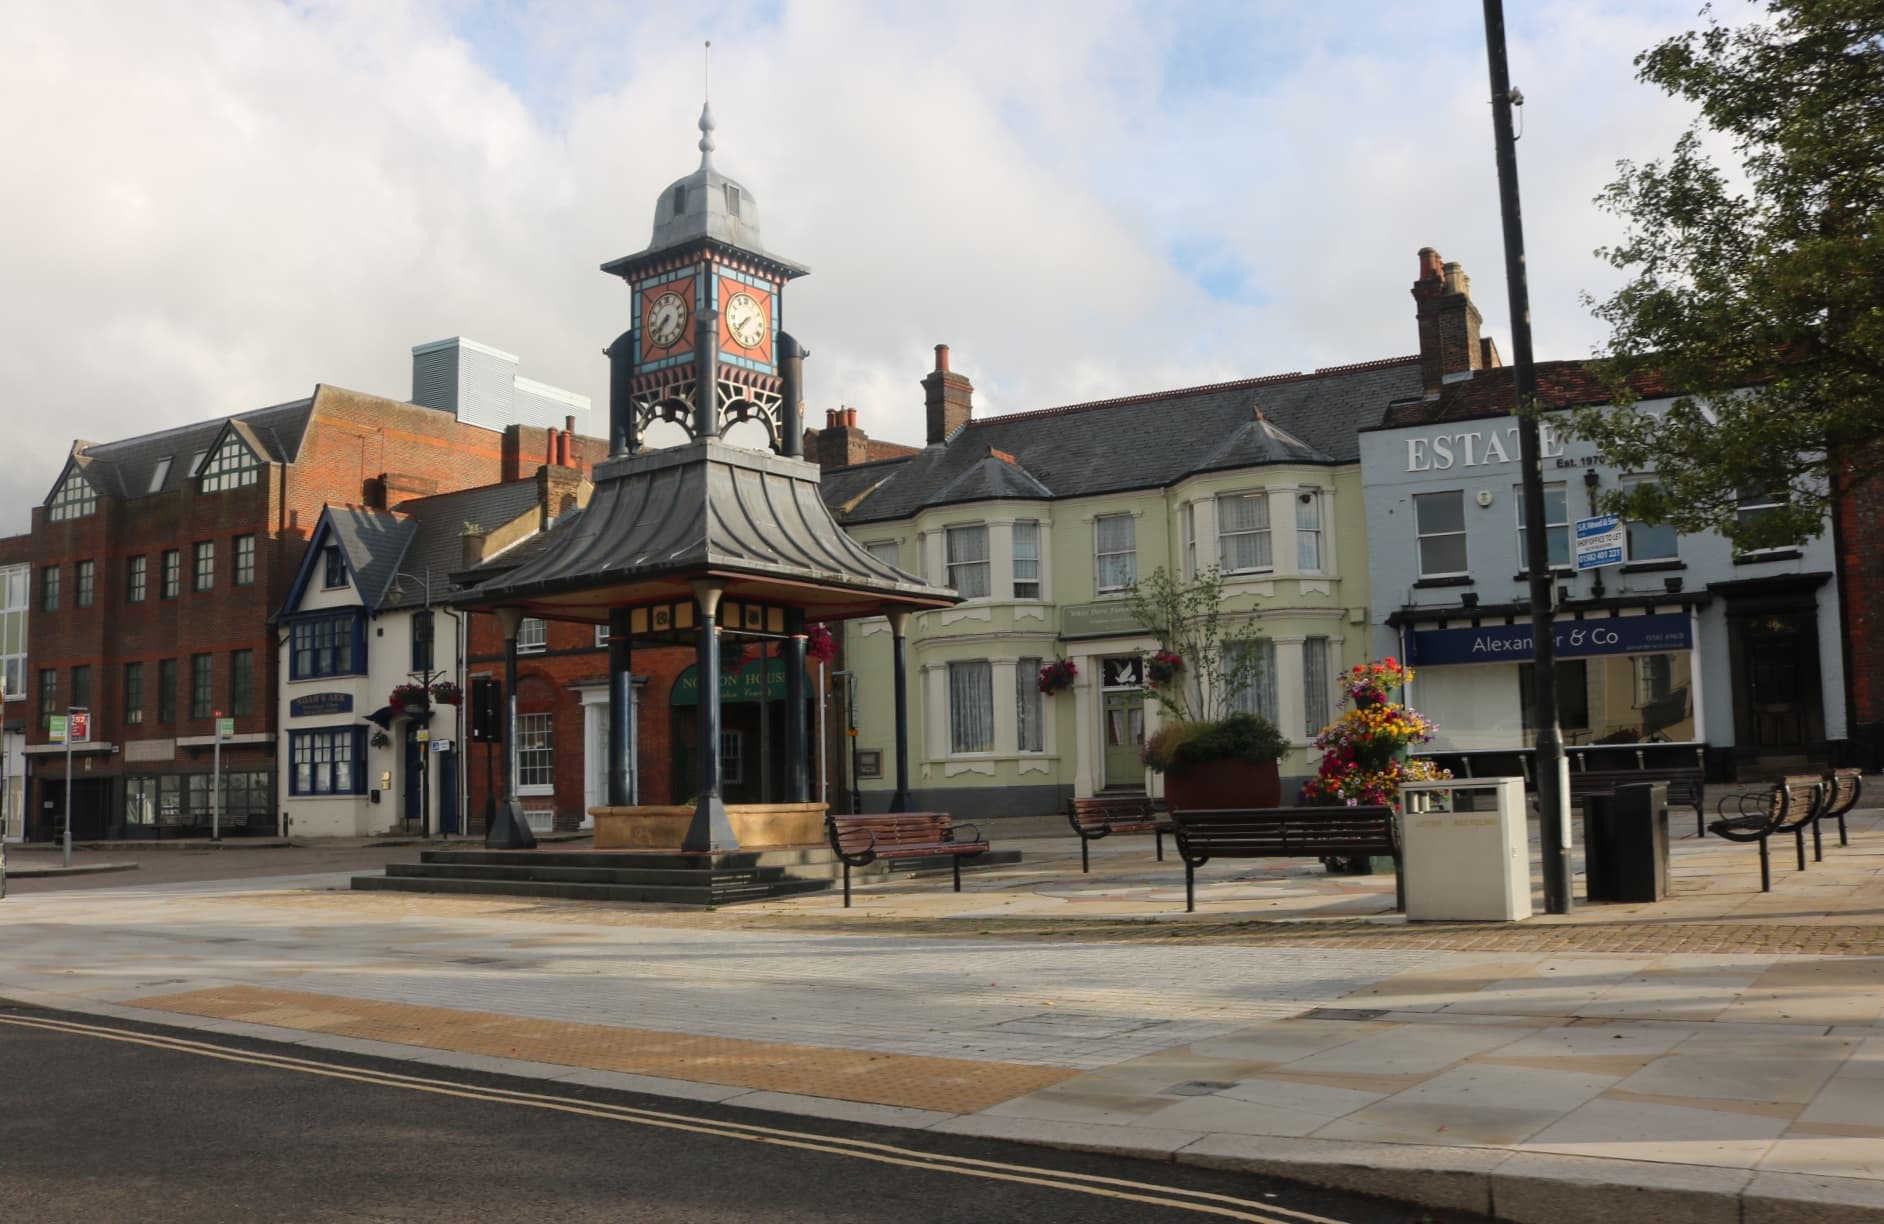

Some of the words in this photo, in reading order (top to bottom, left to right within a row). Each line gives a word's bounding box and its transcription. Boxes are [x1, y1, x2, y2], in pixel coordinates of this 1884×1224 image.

[1556, 458, 1577, 468] Est.
[1472, 635, 1564, 653] Alexanr
[1569, 629, 1587, 646] &
[1592, 628, 1618, 645] Co
